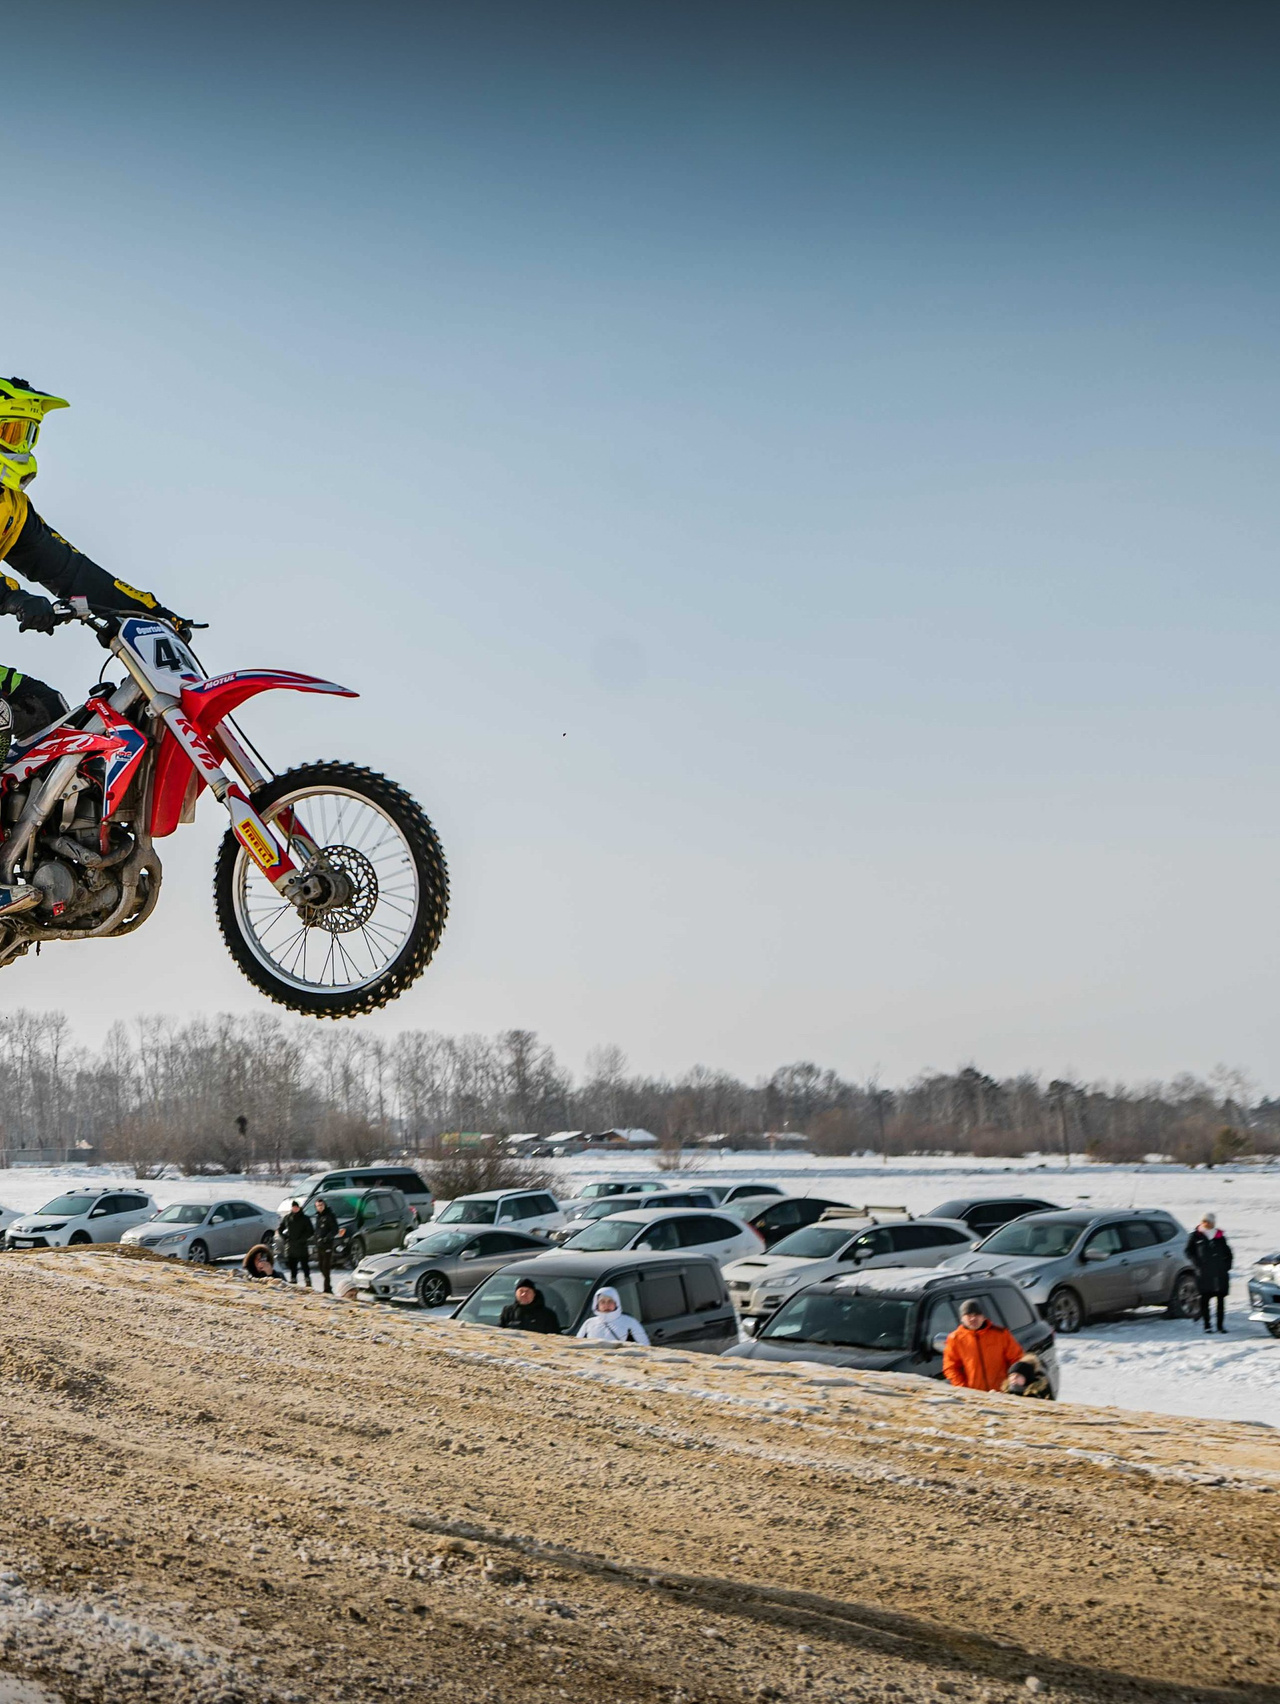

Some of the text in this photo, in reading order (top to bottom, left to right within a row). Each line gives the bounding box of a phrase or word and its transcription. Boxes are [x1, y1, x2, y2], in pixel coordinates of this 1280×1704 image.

[204, 674, 236, 690] MOTUL
[175, 719, 220, 771] KYB
[241, 821, 275, 865] PIRELLI
